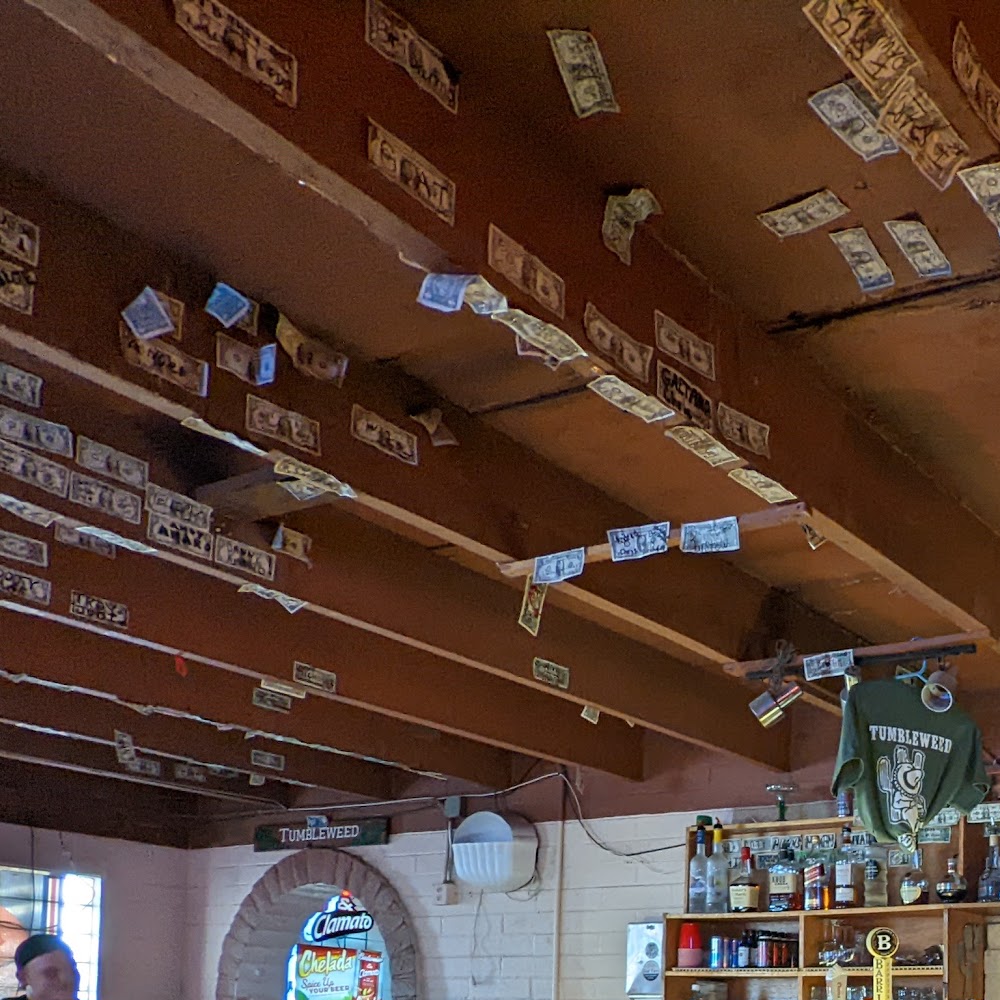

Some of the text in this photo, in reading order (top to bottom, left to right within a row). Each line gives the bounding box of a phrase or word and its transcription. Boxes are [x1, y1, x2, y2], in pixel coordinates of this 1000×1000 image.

[869, 725, 953, 754] TUMBLEWEED
[280, 825, 360, 843] TUMBLEWEED
[315, 913, 372, 939] Clamato
[877, 934, 892, 950] B
[299, 950, 353, 977] Chelada
